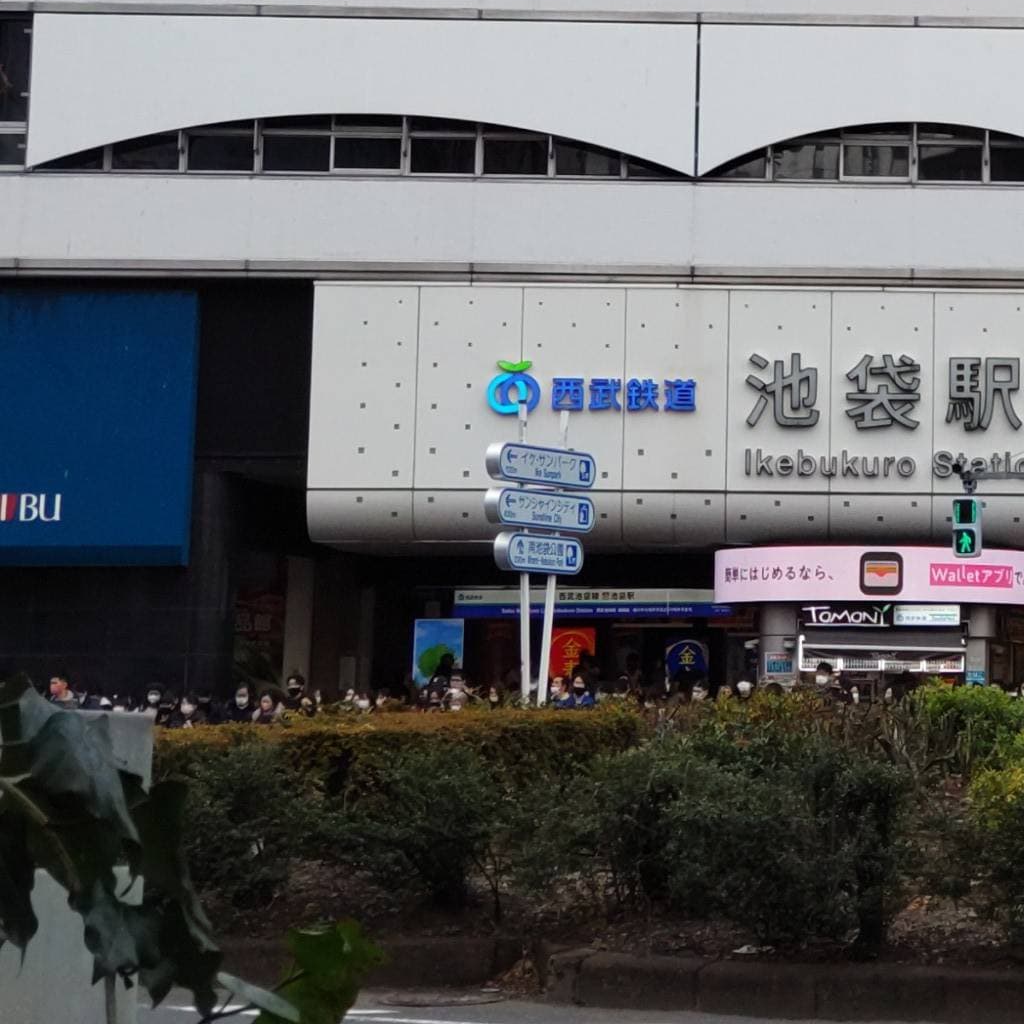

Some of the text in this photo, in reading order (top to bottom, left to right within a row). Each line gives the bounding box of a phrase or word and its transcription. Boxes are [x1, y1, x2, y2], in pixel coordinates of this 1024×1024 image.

[551, 377, 697, 412] 西武鉄道
[745, 352, 1023, 430] 池袋駅
[744, 448, 916, 477] Ikebukuro
[0, 492, 62, 522] IBU
[724, 564, 835, 583] 簡単にはじめるなら、
[802, 604, 891, 626] TOMONY
